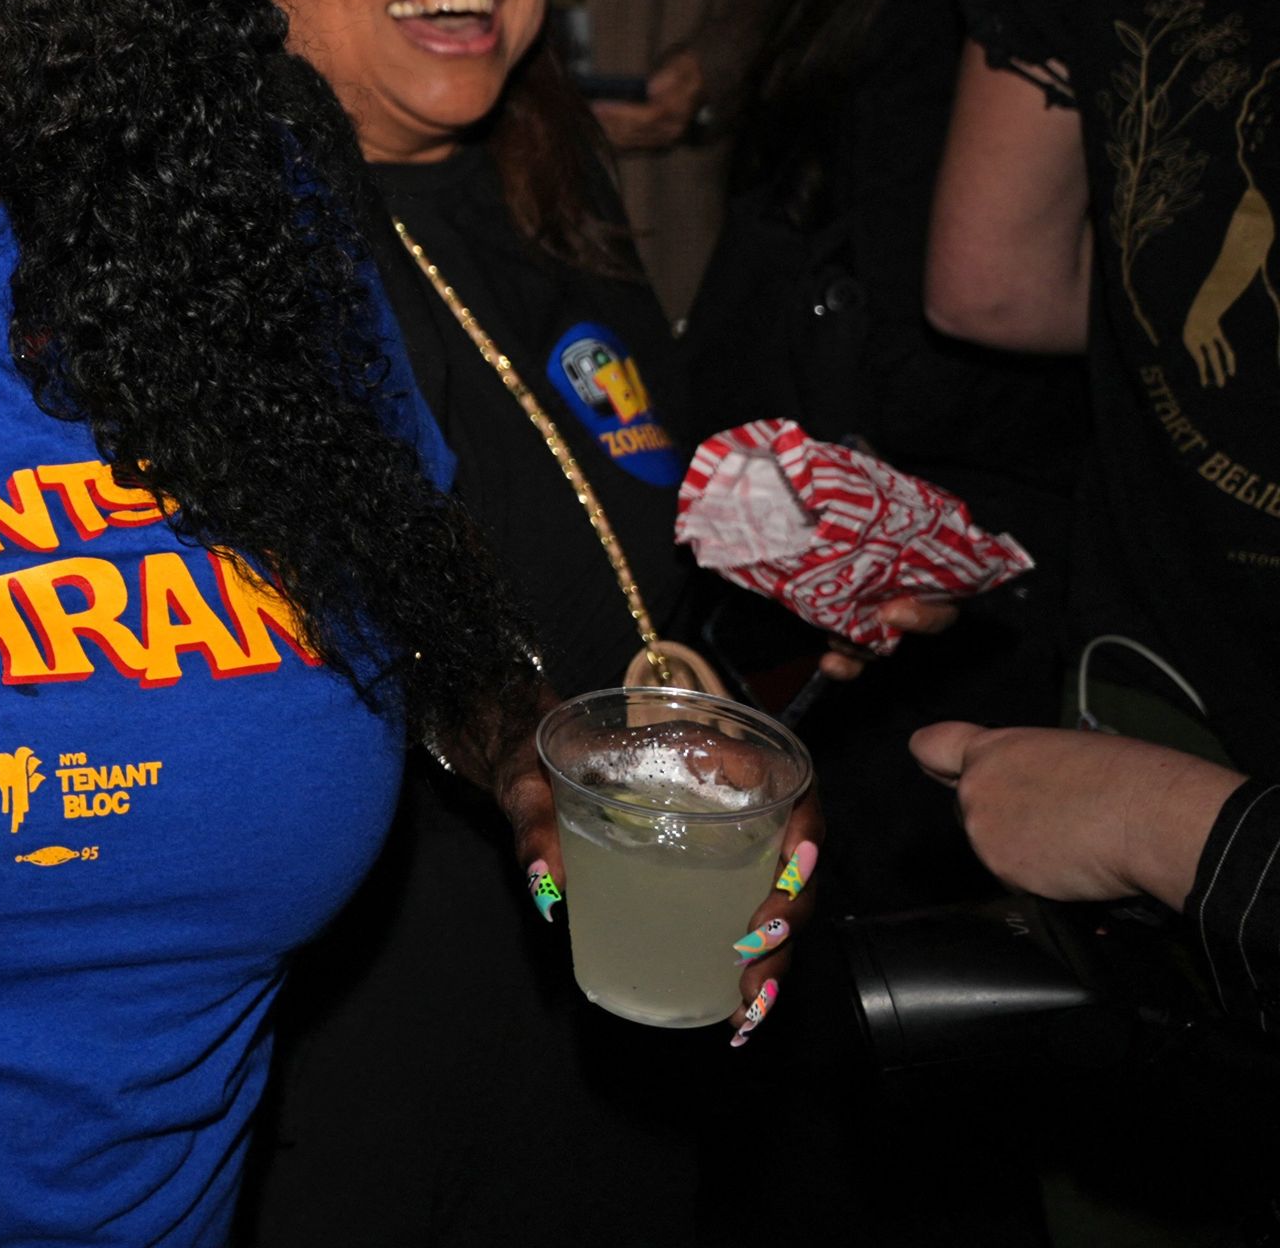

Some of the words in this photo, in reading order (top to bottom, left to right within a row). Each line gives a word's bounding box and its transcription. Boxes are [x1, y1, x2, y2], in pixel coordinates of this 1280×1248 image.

[1140, 365, 1211, 453] START
[58, 752, 88, 767] NYS
[55, 761, 163, 793] TENANT
[62, 790, 130, 819] BLOC
[81, 846, 100, 861] 95
